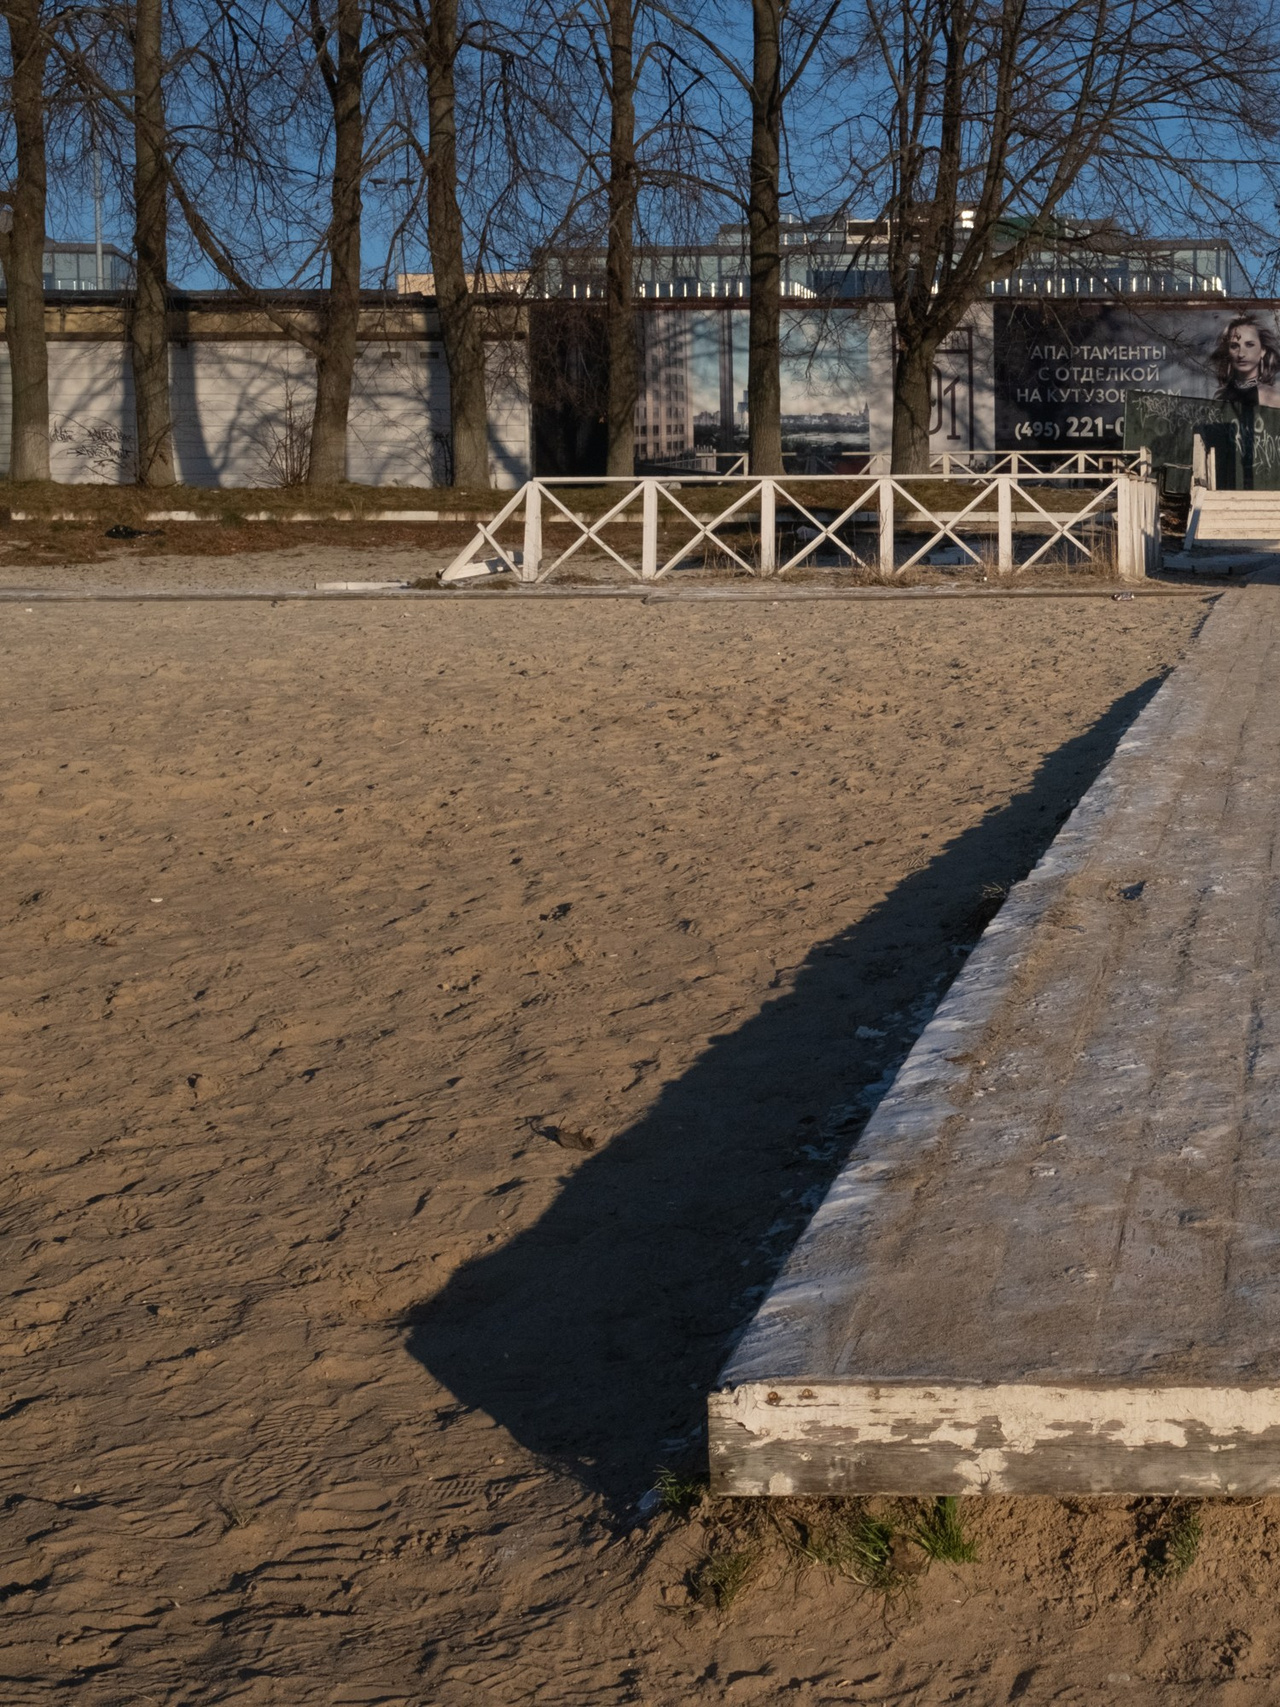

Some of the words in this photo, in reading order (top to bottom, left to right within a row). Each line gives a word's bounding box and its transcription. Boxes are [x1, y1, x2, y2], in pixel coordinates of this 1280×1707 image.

[1030, 345, 1167, 360] АПАРТАМЕНТЫ
[1038, 367, 1050, 381] С
[1055, 363, 1160, 384] ОТДЕЛКОЙ
[1016, 388, 1042, 402] НА
[1047, 388, 1182, 403] КУТУЗОВ
[1014, 420, 1061, 440] (495)
